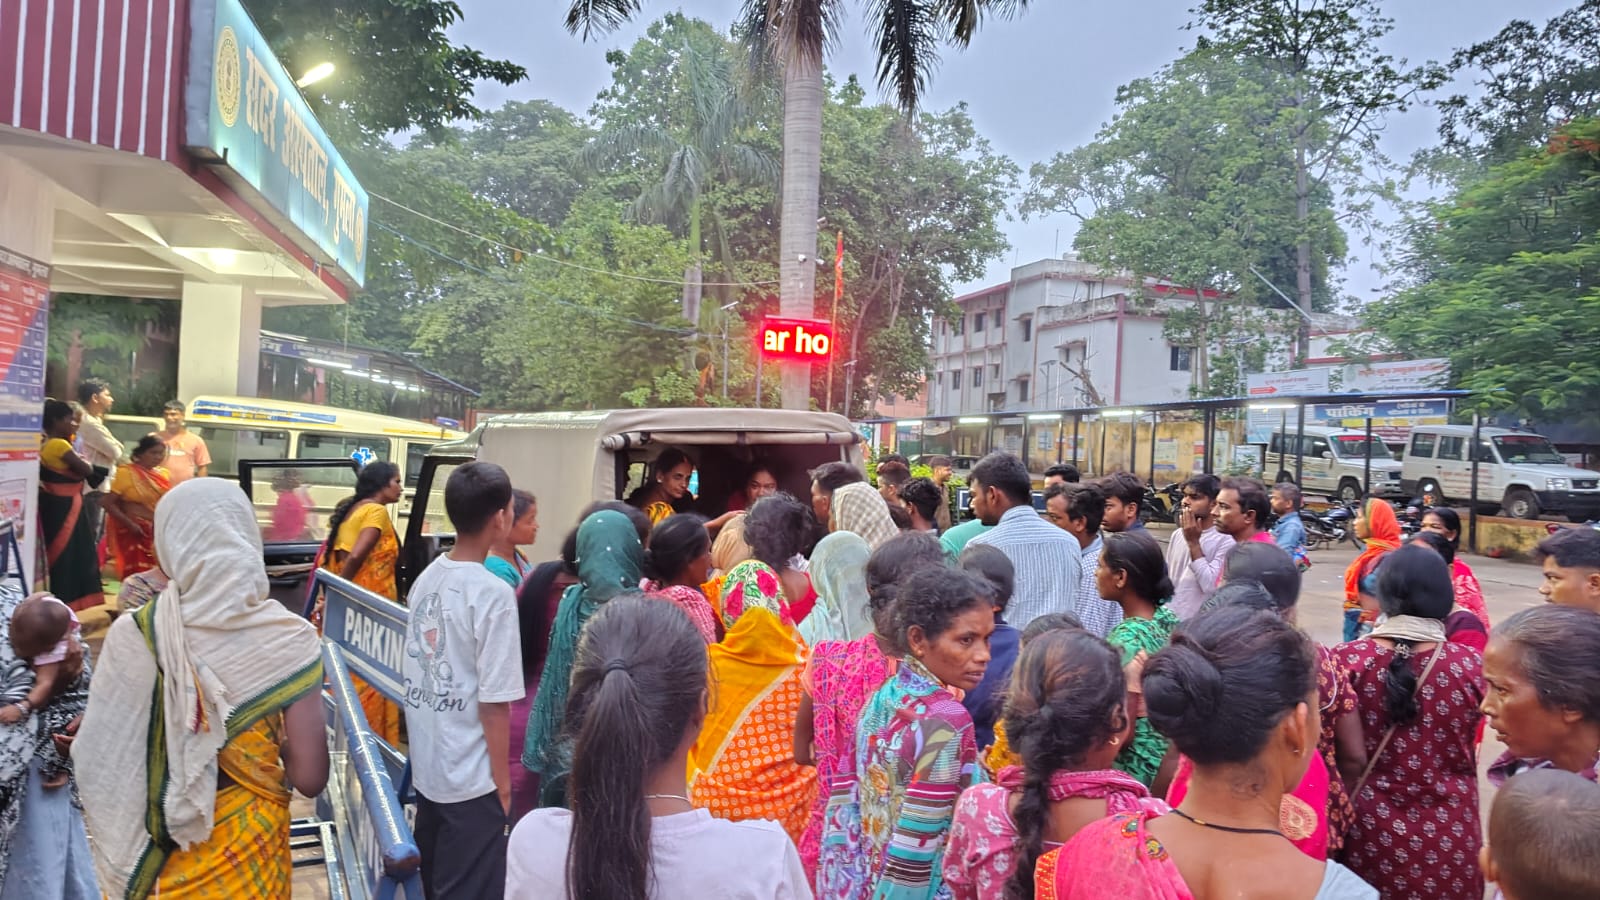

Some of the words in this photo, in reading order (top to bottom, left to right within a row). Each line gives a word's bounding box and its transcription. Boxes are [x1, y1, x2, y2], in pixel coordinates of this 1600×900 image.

[245, 47, 279, 153] सदर
[333, 168, 356, 245] गुमला
[764, 329, 790, 352] ar
[795, 325, 829, 355] ho
[343, 607, 404, 674] PARKIN
